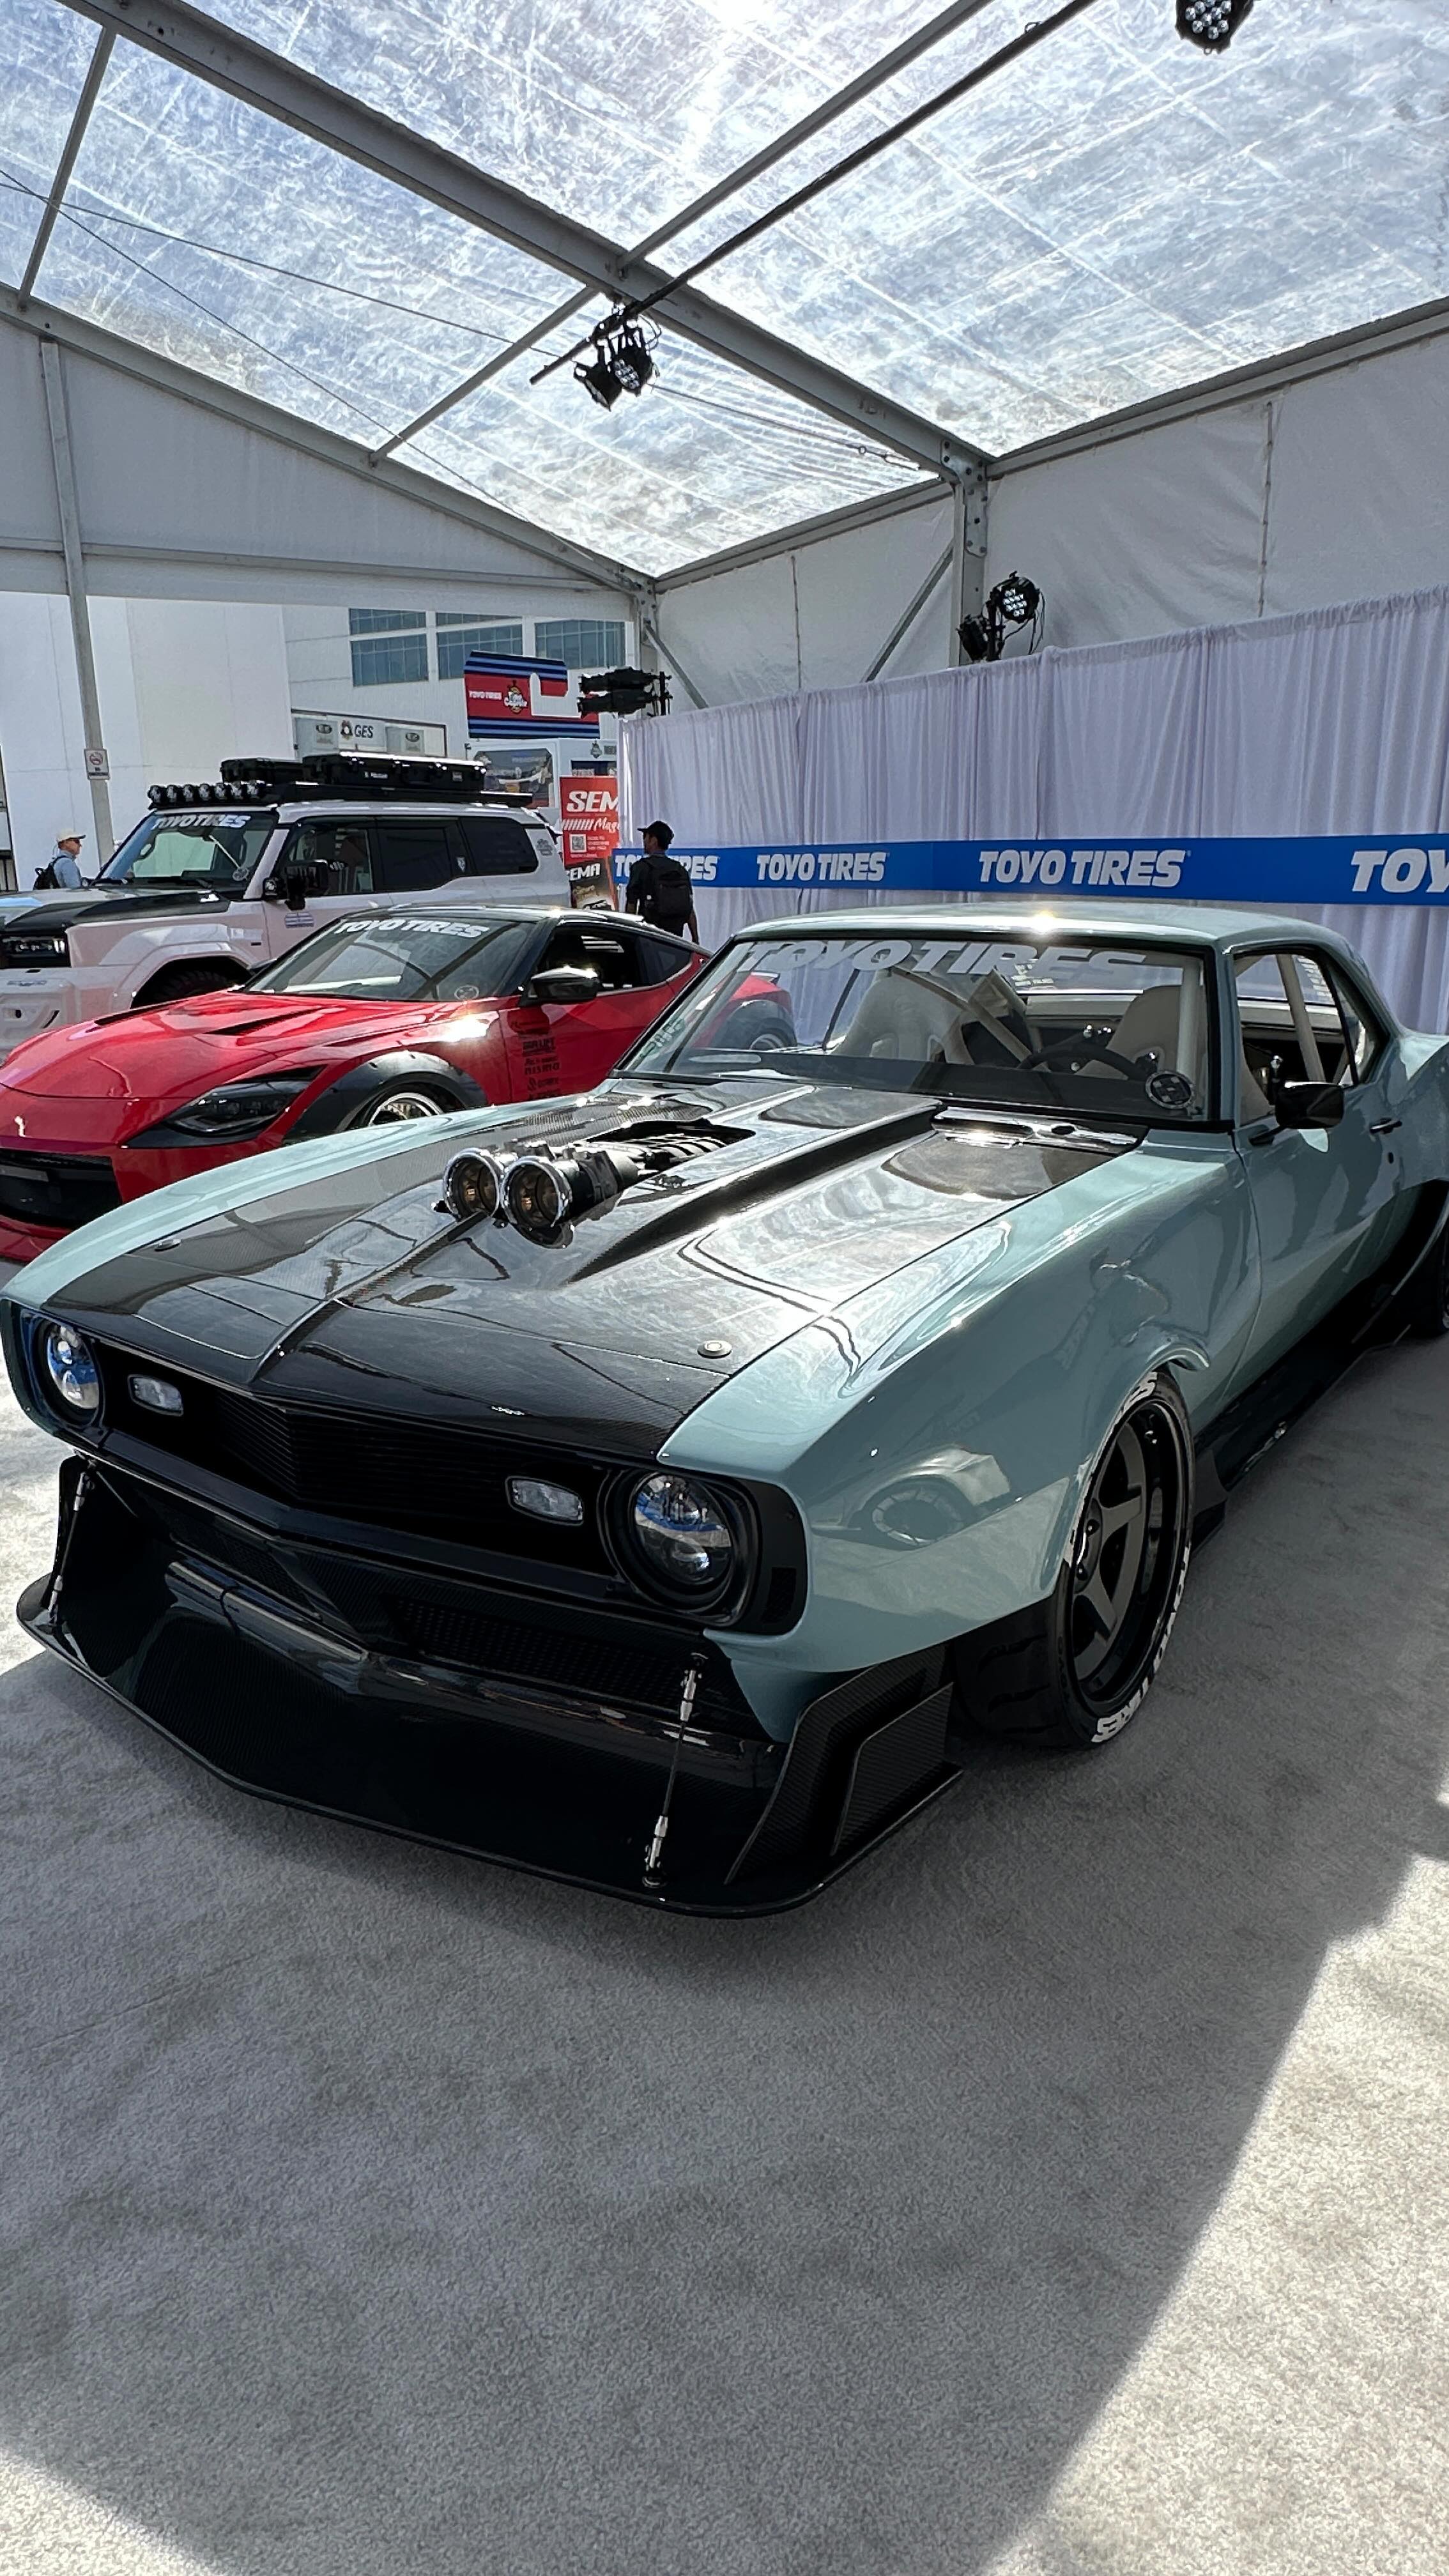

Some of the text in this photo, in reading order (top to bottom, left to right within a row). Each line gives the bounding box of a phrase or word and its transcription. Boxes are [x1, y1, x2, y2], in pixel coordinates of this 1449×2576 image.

[354, 724, 374, 739] GES
[193, 814, 251, 829] TIRES
[756, 852, 887, 882] TOYO TIRES
[979, 850, 1186, 888] TOYO TIRES
[334, 919, 490, 939] TOYO TIRES
[737, 940, 912, 972] TOYO
[911, 940, 1147, 977] TIRES
